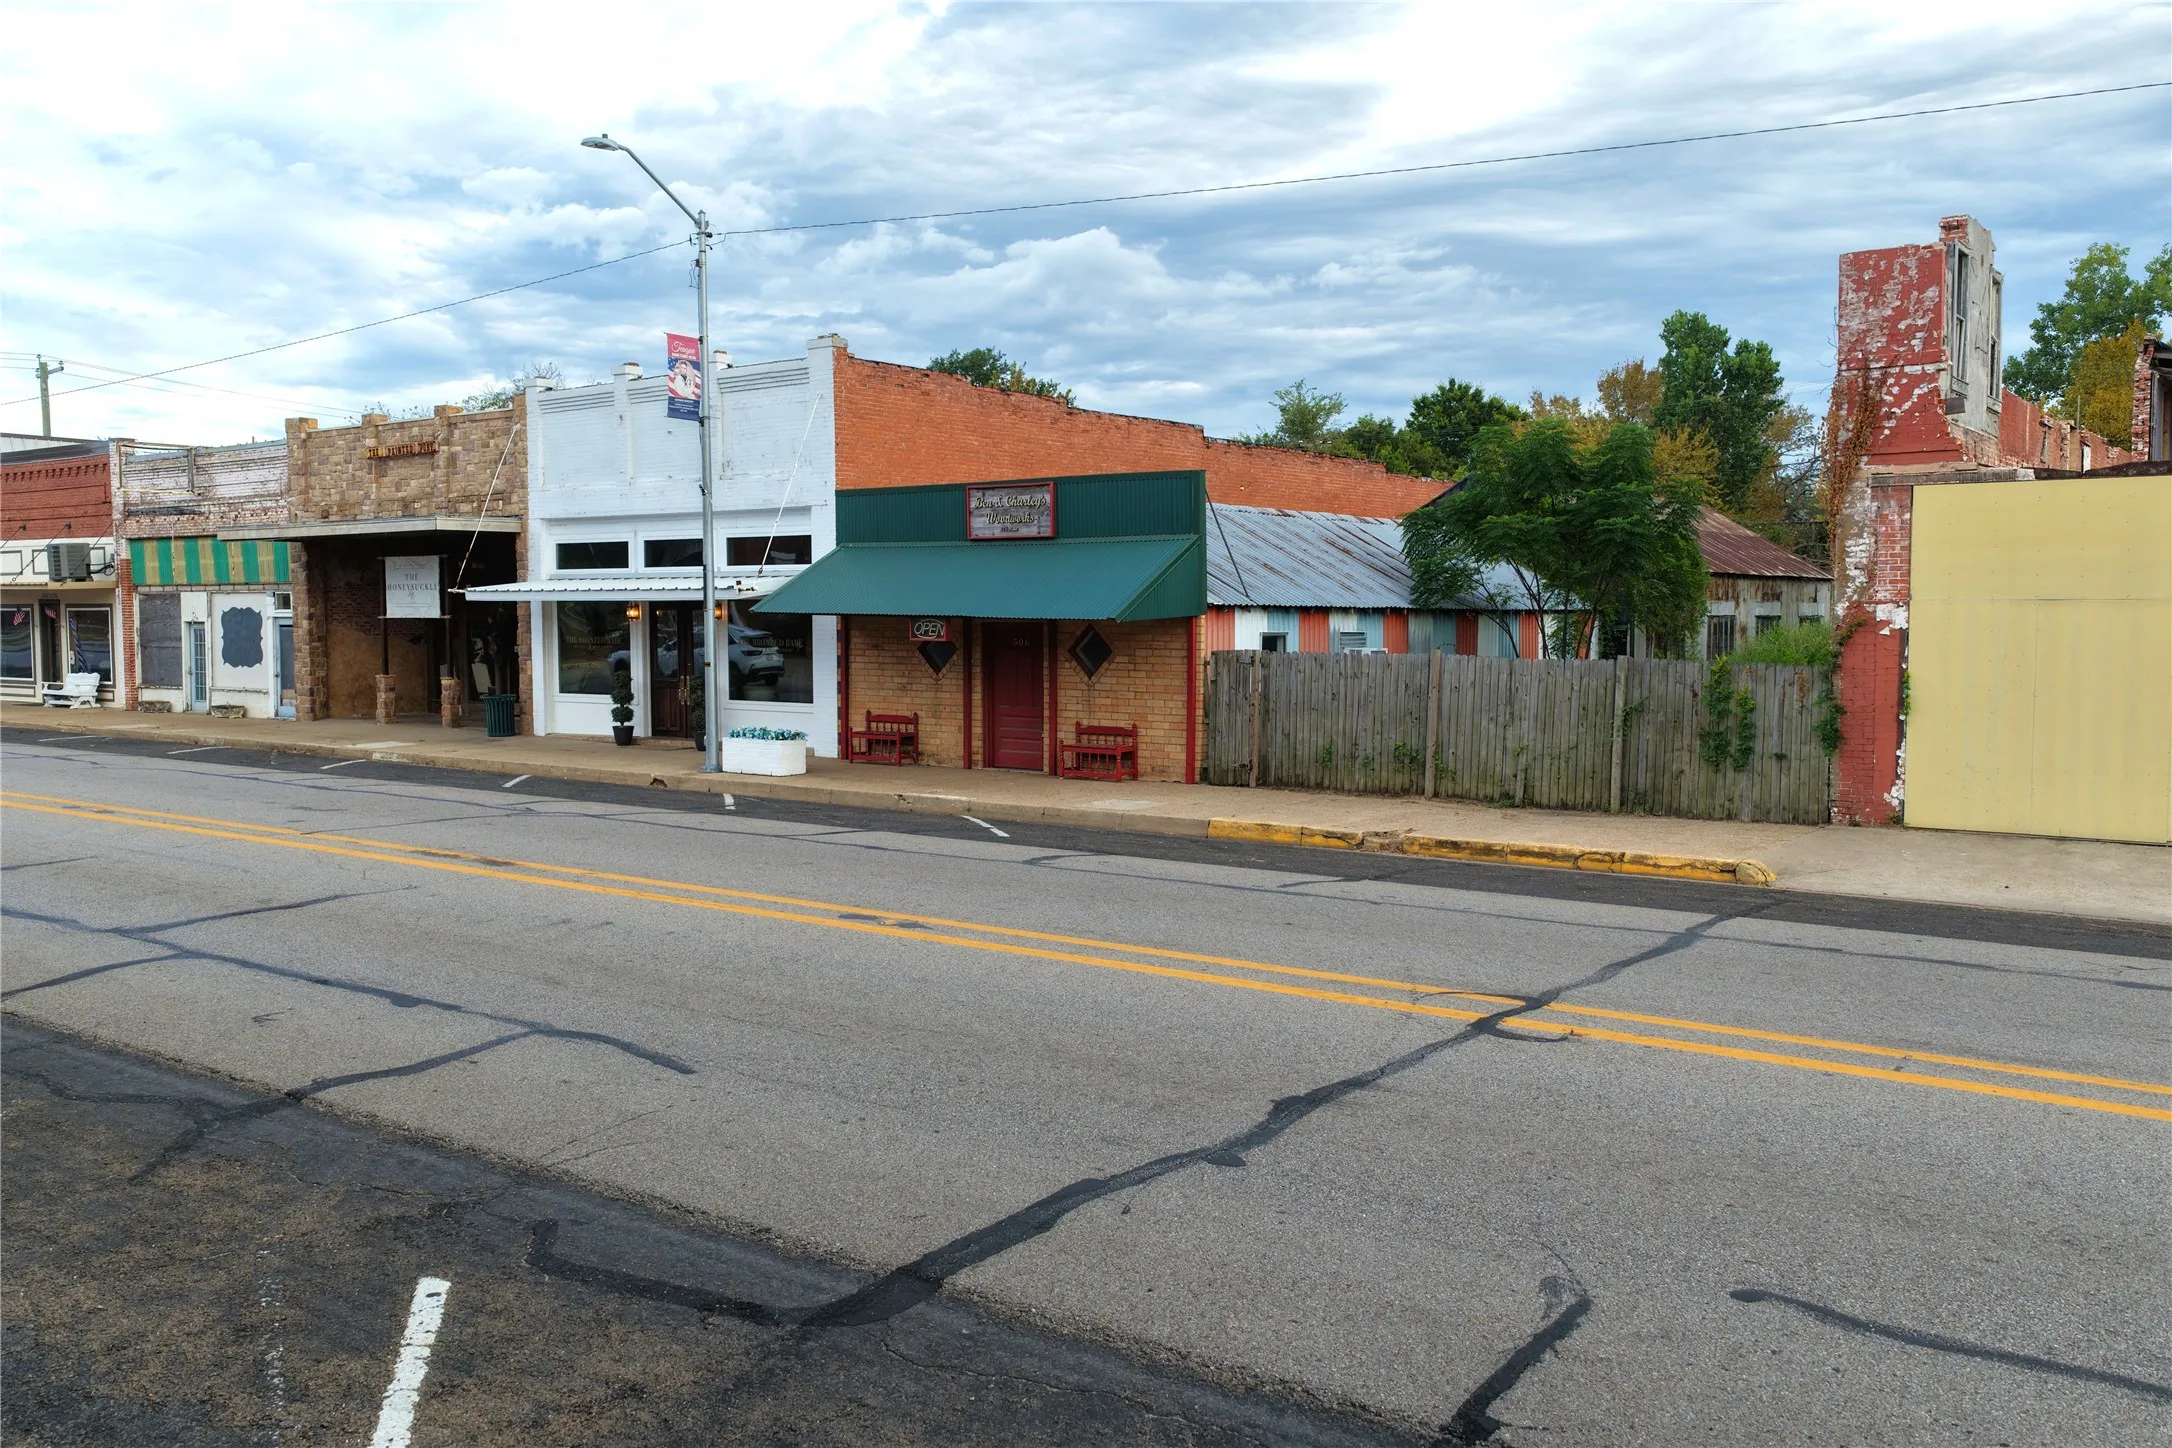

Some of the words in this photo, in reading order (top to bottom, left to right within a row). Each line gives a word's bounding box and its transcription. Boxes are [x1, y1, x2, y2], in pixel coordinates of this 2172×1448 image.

[975, 497, 993, 509] Ben
[1006, 494, 1047, 509] Charley's
[986, 512, 1034, 525] Woodworks
[404, 573, 419, 581] THE
[387, 583, 438, 591] HONEYSUCKLE
[914, 622, 945, 637] OPEN
[1012, 638, 1030, 647] 506
